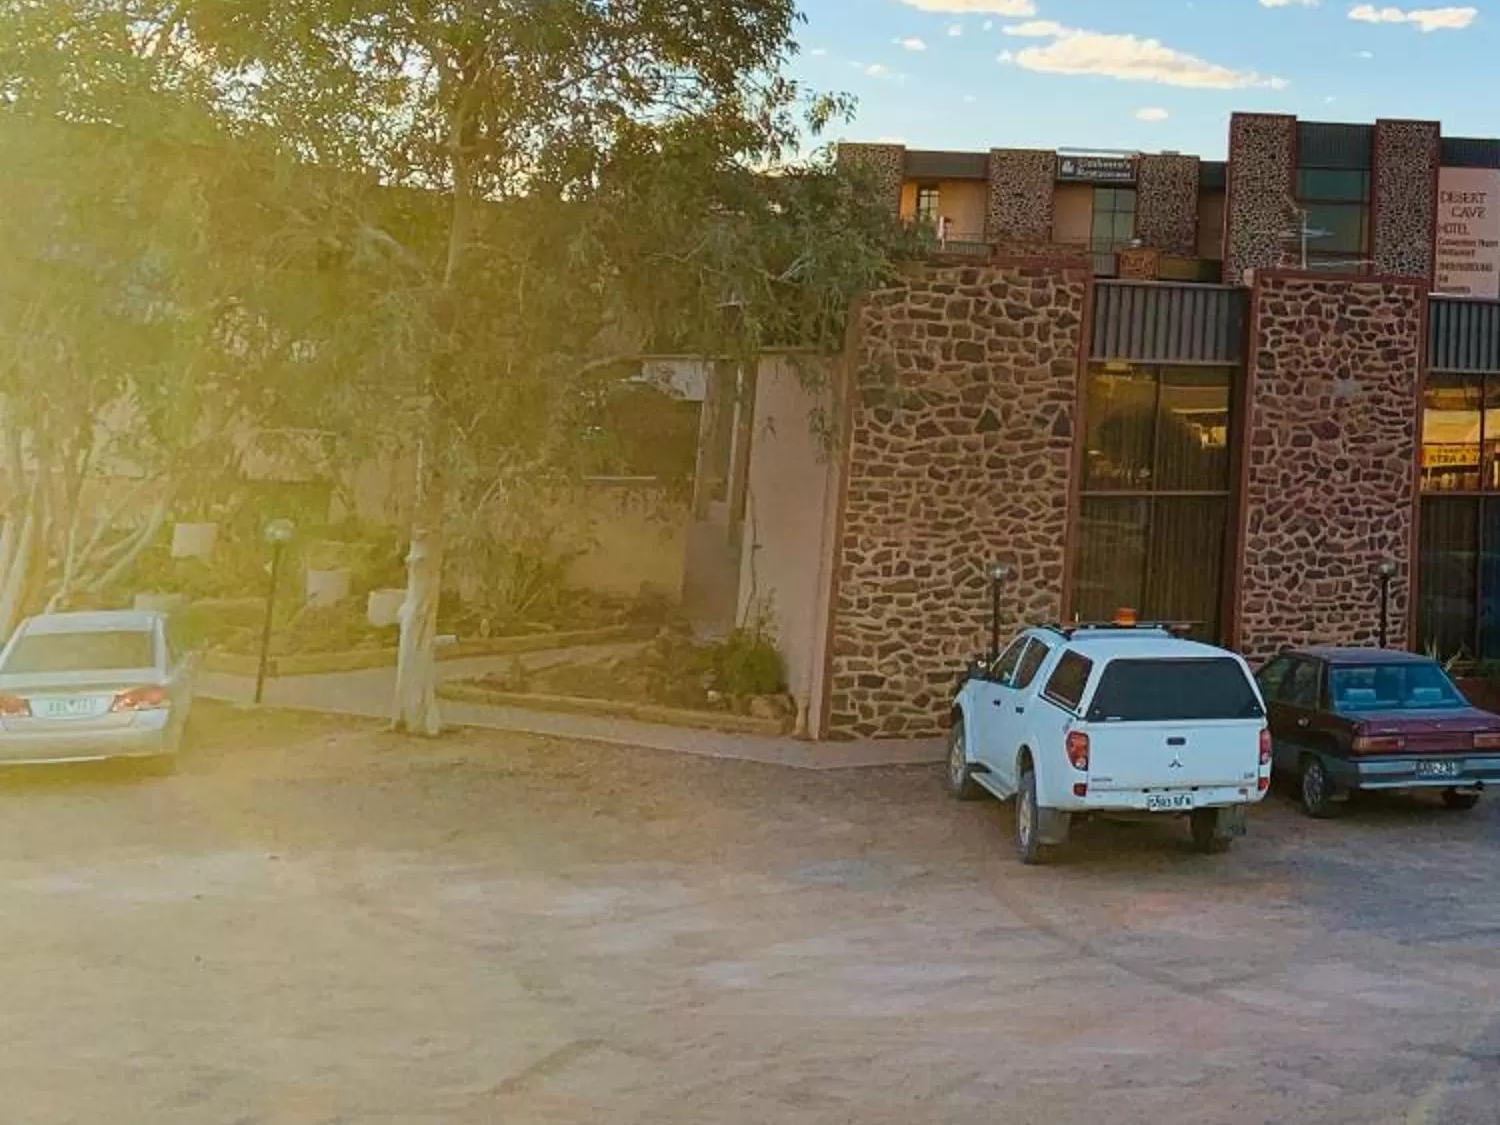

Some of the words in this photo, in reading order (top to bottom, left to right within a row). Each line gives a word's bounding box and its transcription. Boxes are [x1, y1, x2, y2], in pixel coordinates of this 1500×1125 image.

[1440, 191, 1487, 204] DESERT
[1451, 207, 1486, 219] CAVE
[1437, 223, 1470, 235] HOTEL
